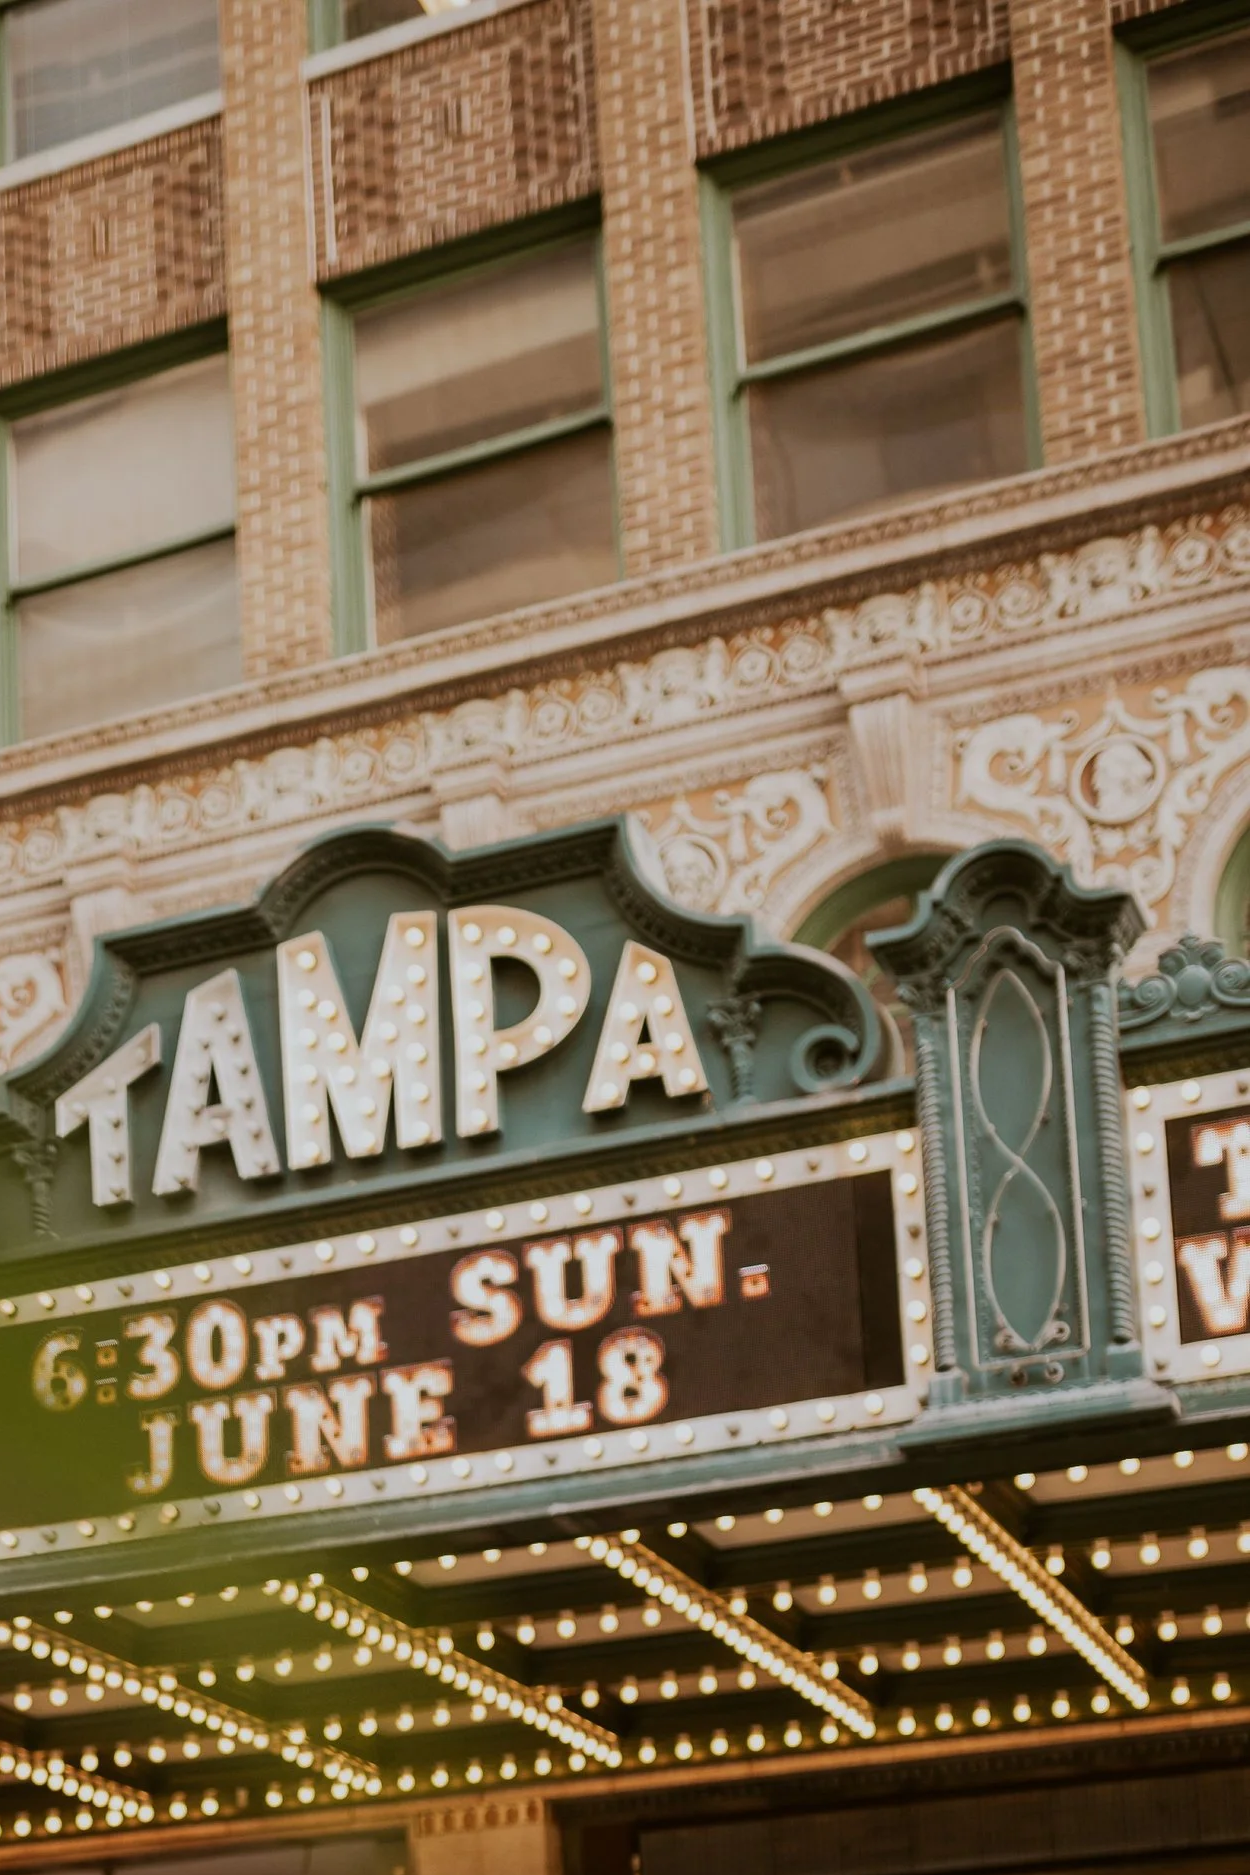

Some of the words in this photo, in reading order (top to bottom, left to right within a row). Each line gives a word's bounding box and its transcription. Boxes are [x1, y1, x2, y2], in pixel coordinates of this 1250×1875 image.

[55, 904, 711, 1206] TAMPA
[450, 1207, 771, 1347] SUN.
[126, 1359, 456, 1495] JUNE
[521, 1325, 669, 1438] 18
